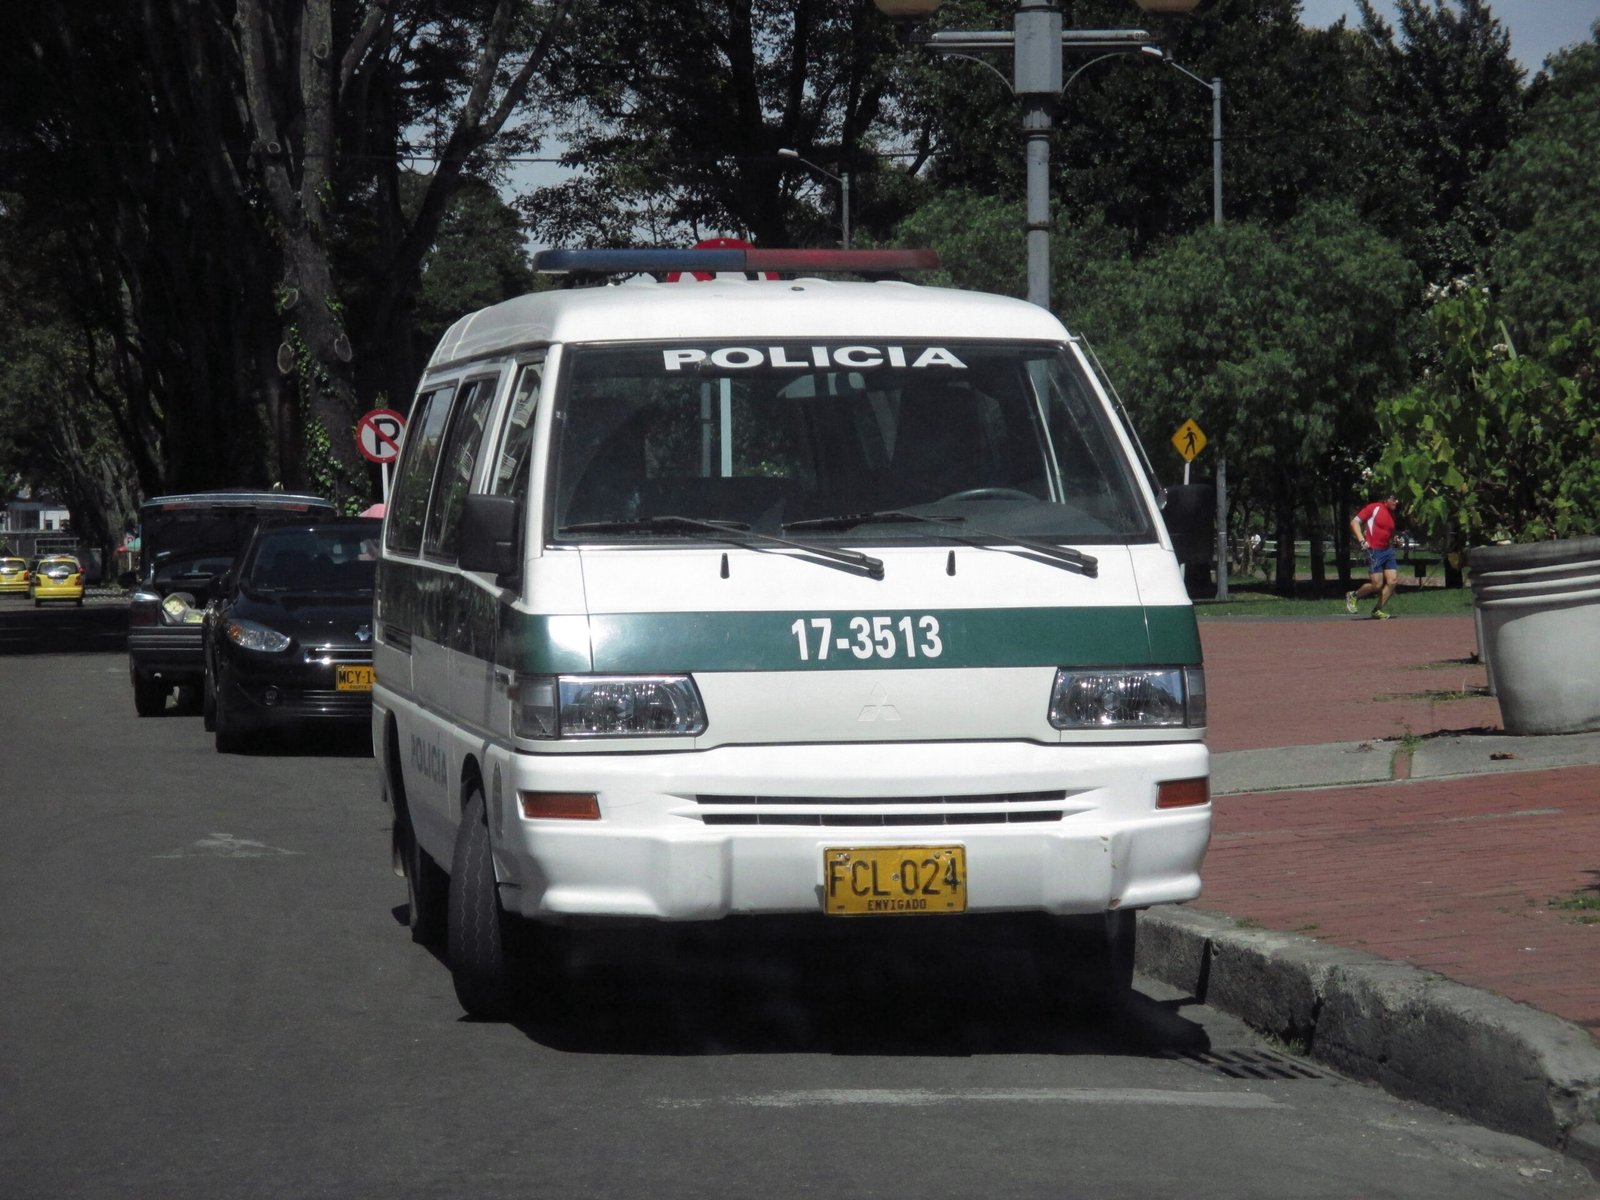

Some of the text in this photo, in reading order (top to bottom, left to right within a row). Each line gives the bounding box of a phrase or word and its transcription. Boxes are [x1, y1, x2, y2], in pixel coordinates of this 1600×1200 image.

[662, 345, 968, 371] POLICIA
[791, 615, 943, 660] 17-3513
[338, 670, 377, 685] MCY-1
[829, 857, 961, 897] FCL 024
[867, 898, 928, 911] ENVIGADO
